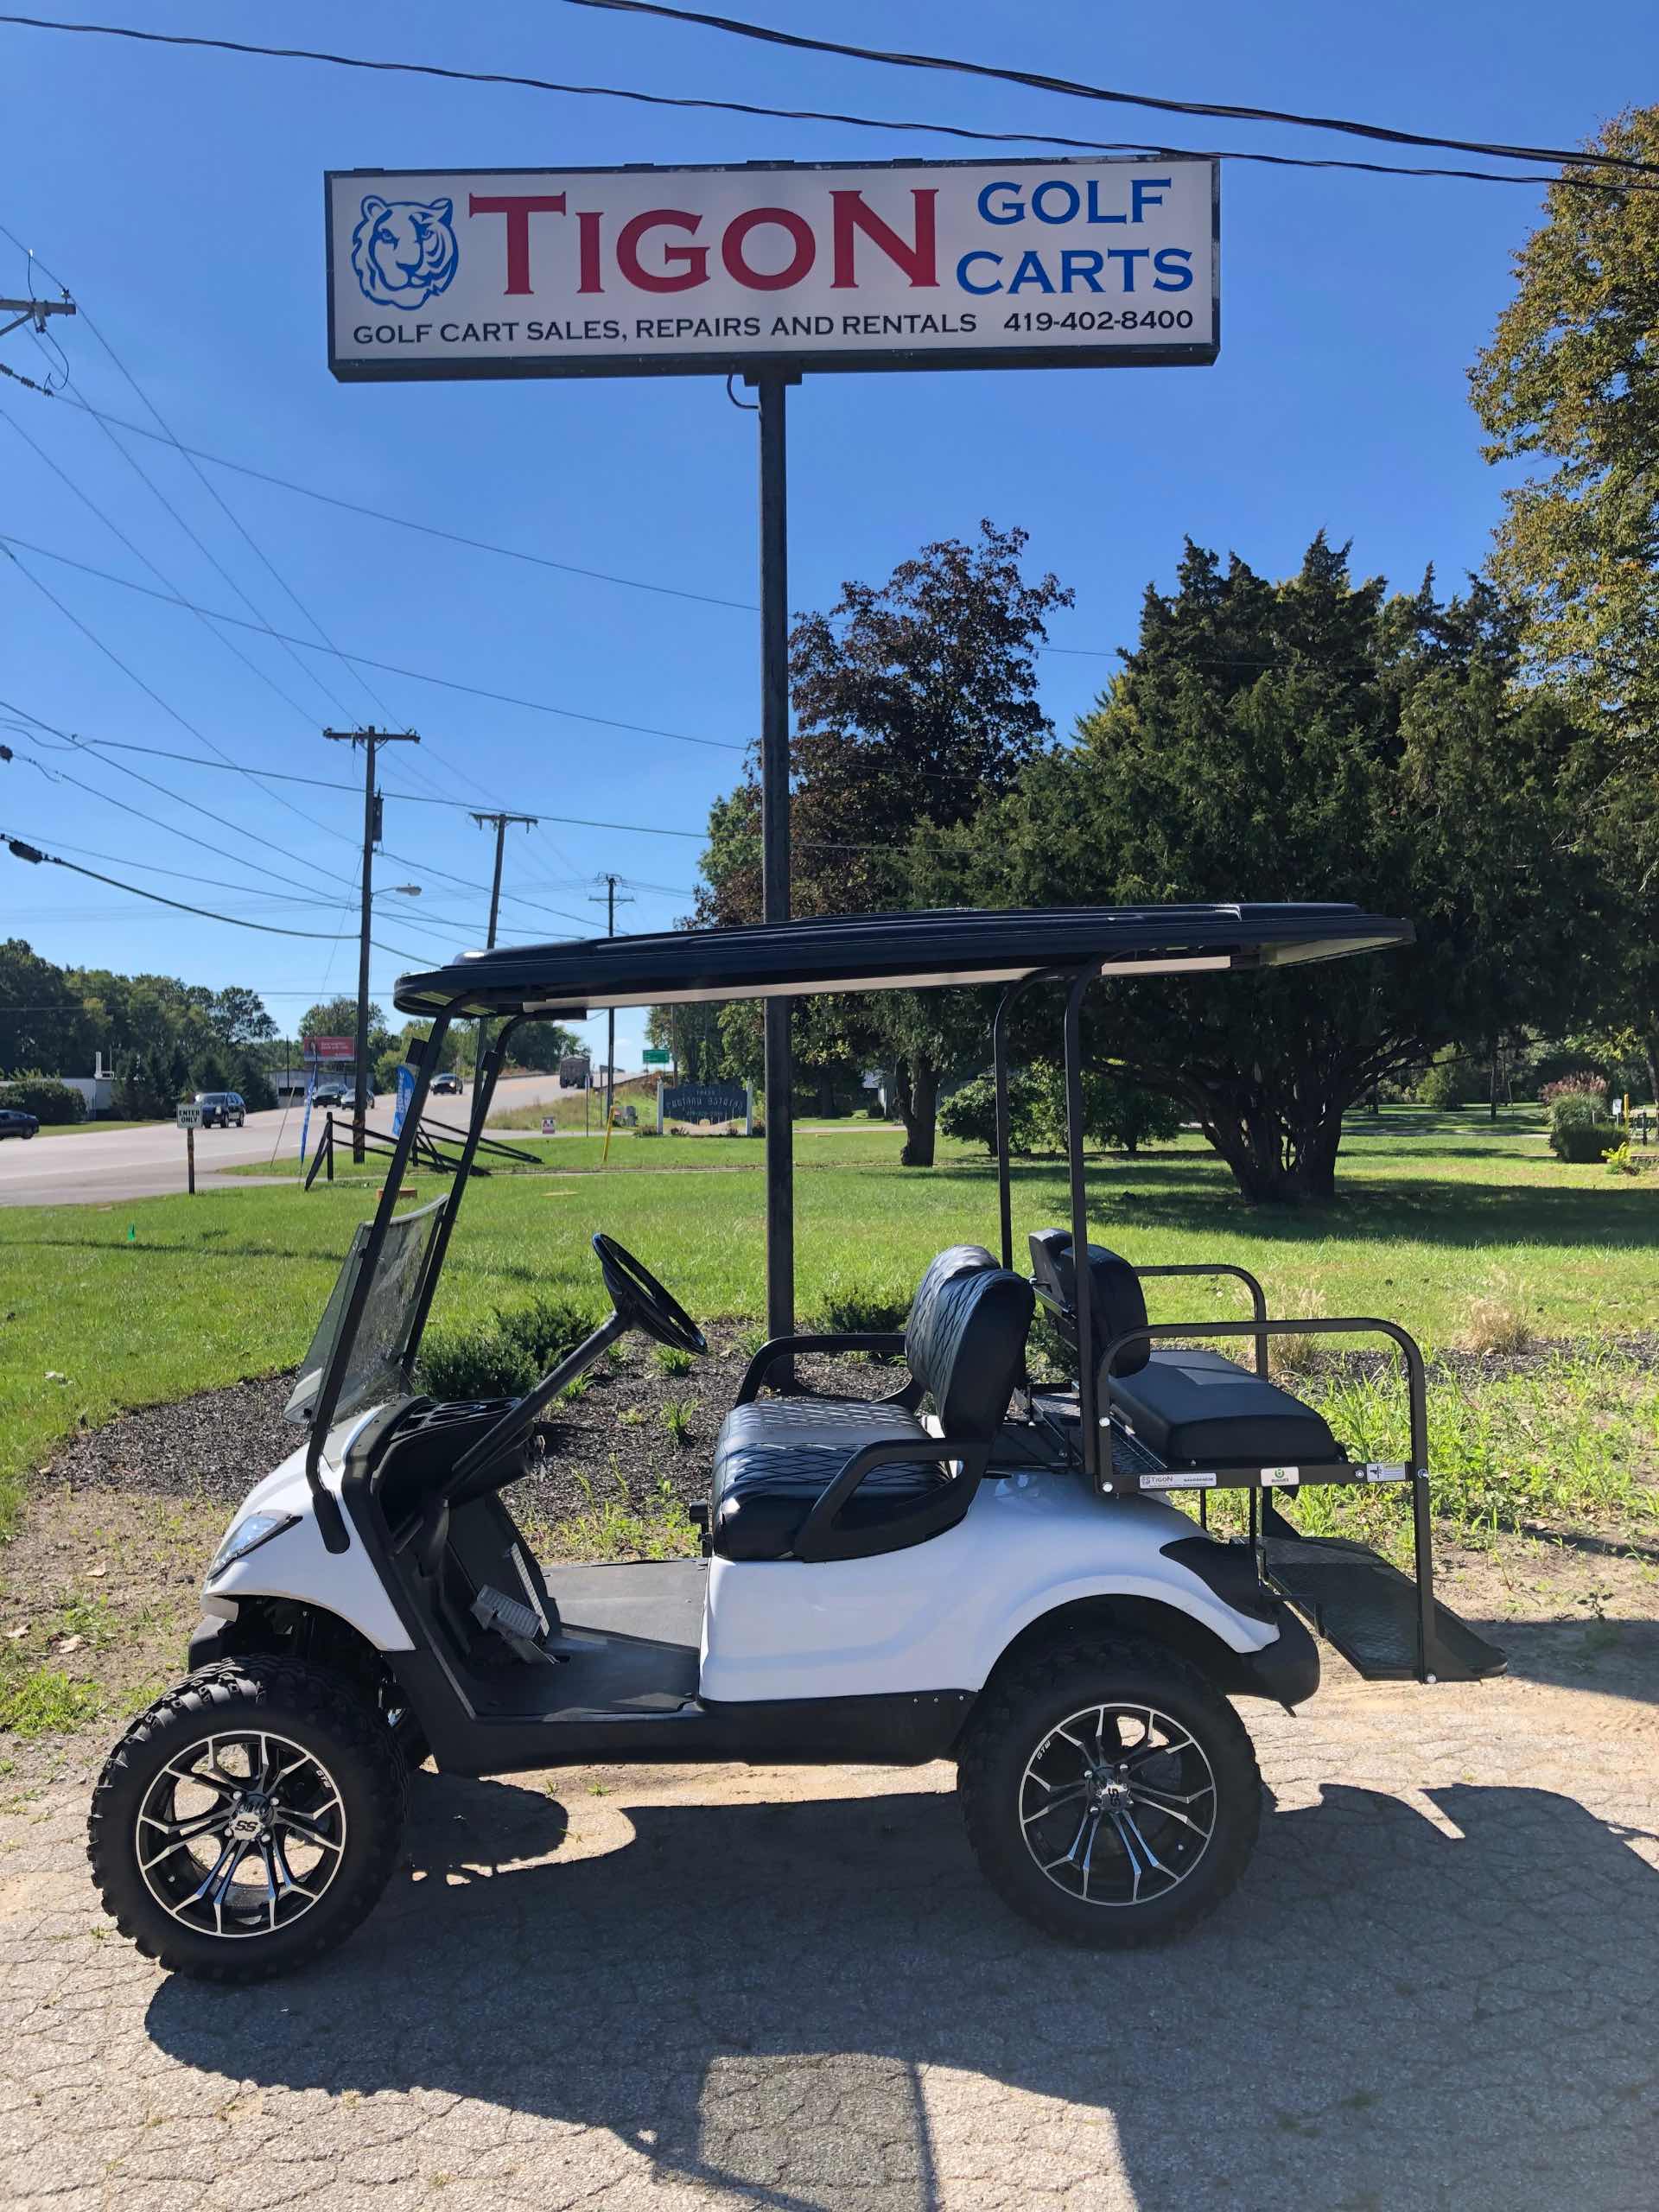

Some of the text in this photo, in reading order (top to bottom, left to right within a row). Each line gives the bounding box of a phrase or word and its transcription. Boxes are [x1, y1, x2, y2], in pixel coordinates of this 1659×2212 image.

[977, 177, 1172, 226] GOLF
[956, 248, 1194, 296] CARTS
[353, 313, 977, 345] GOLF CART SALES, REPAIRS AND RENTALS
[1003, 310, 1194, 333] 419-402-8400
[234, 1820, 259, 1833] SS
